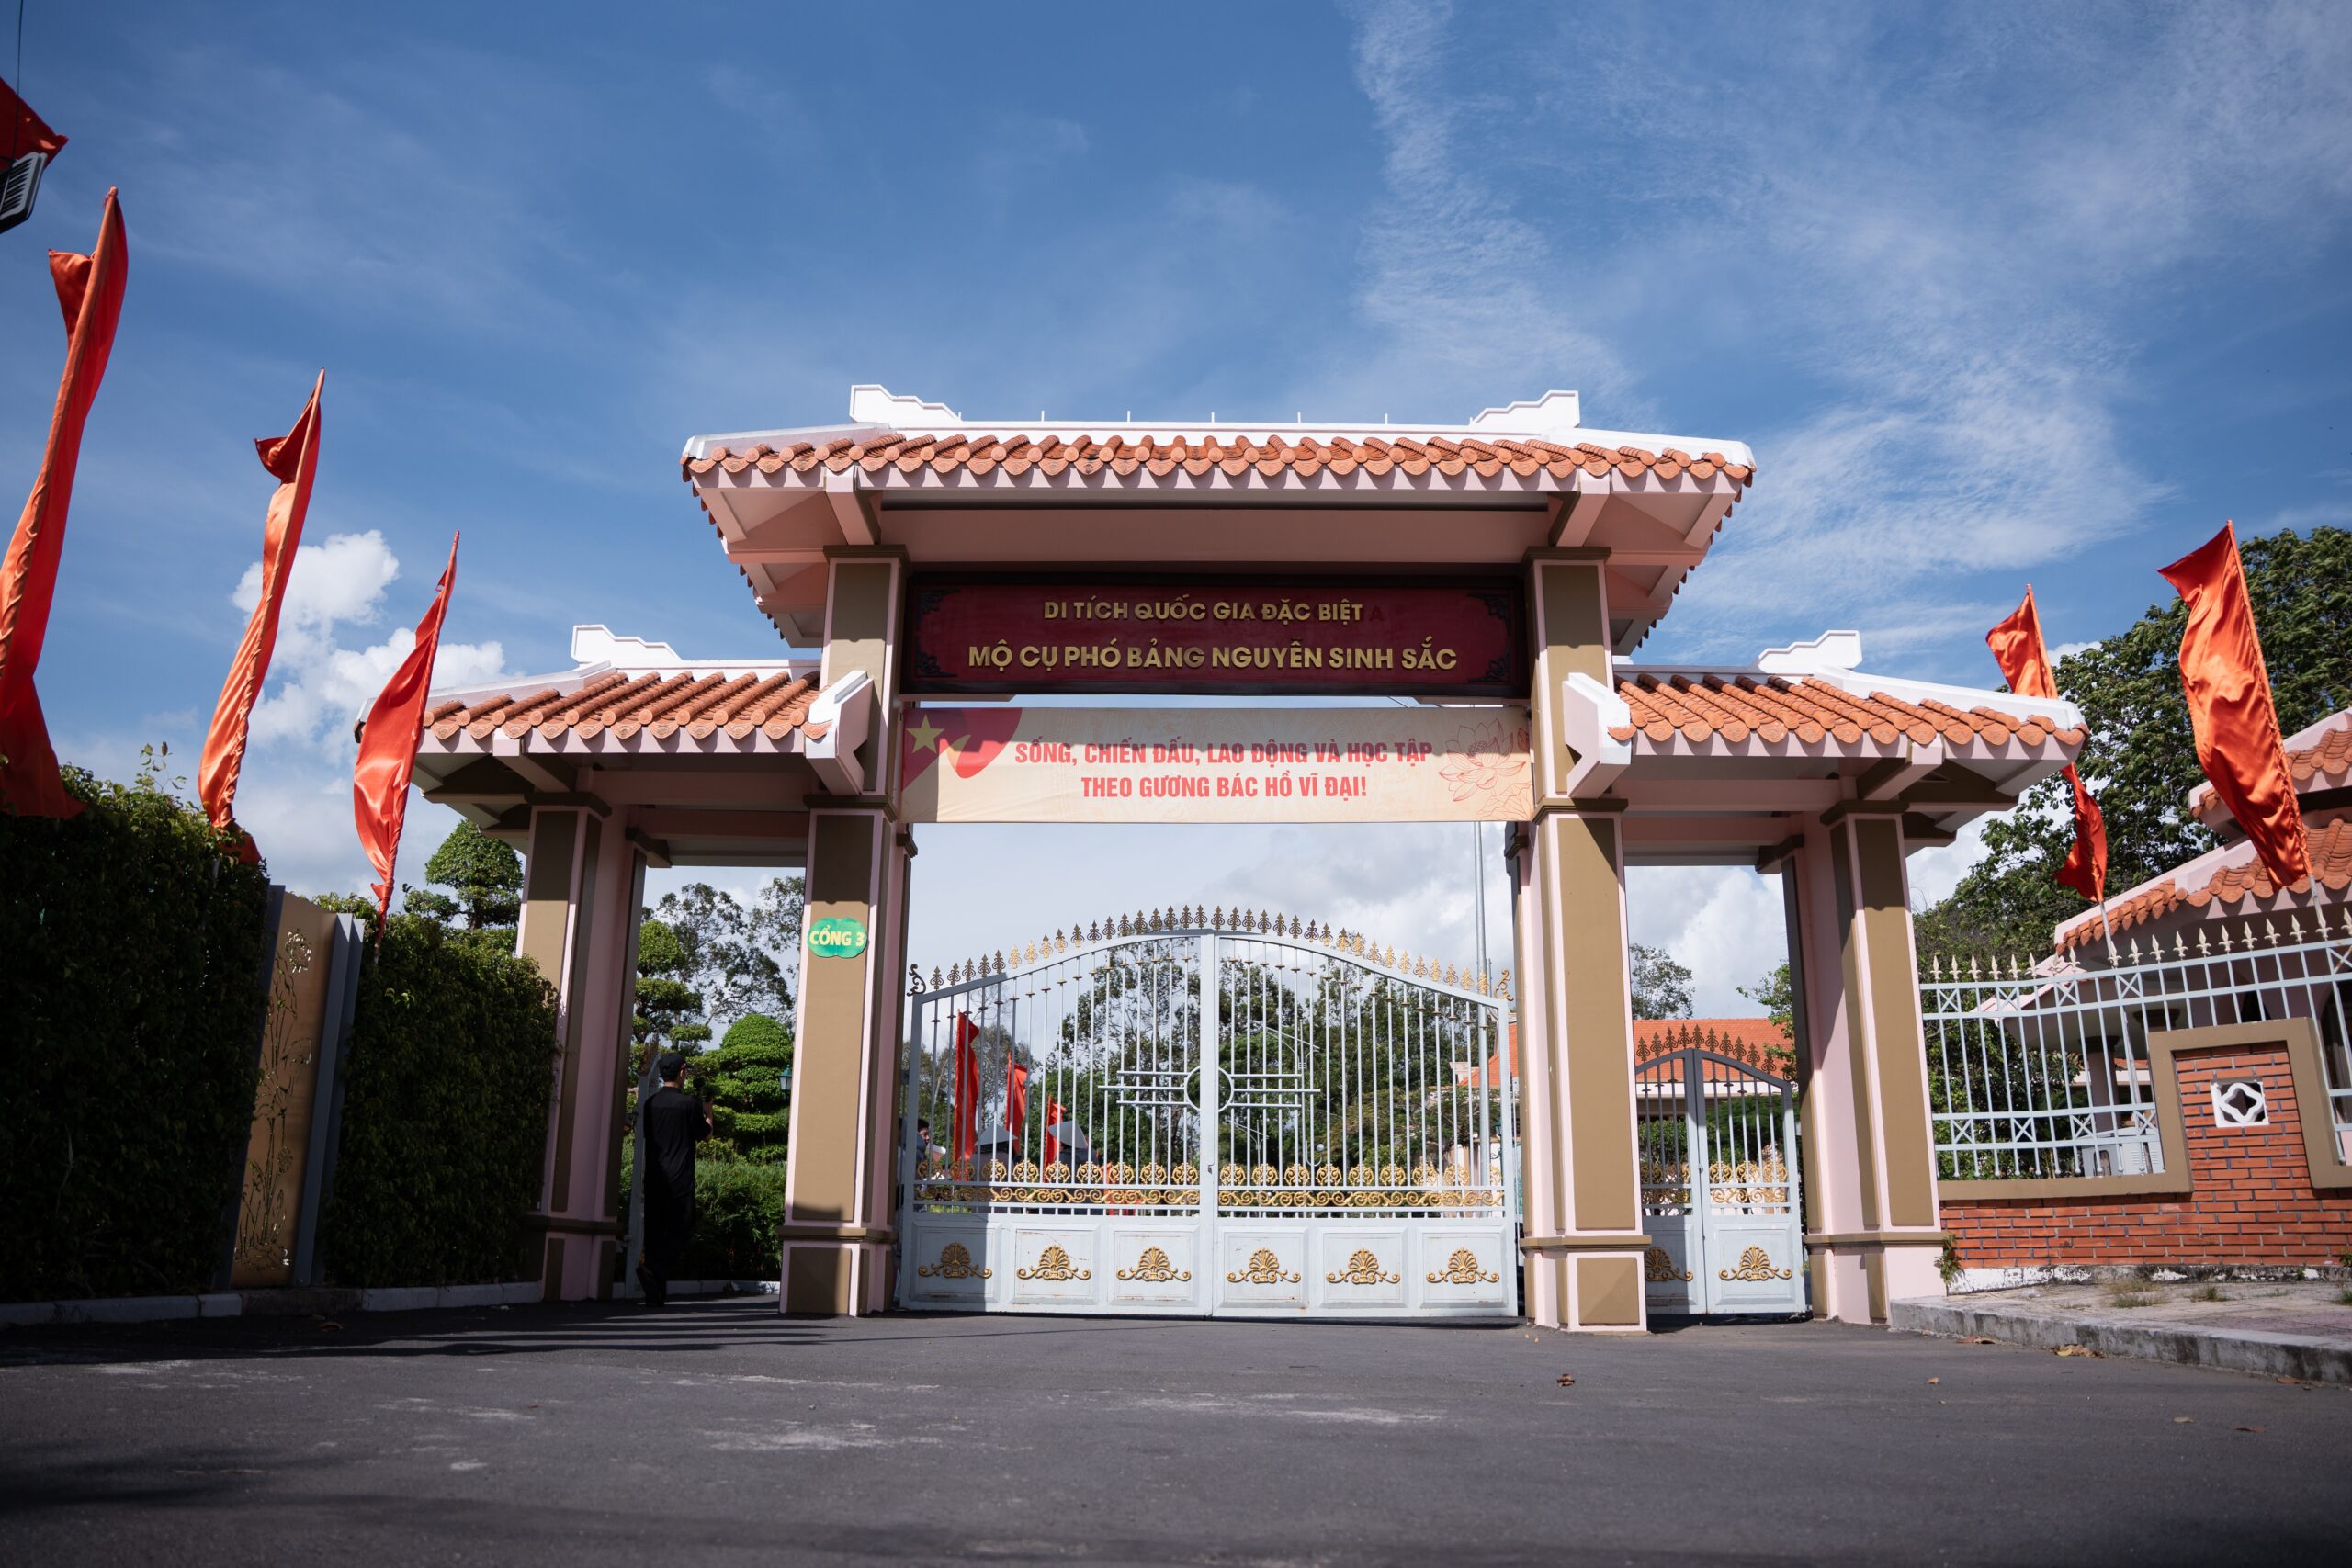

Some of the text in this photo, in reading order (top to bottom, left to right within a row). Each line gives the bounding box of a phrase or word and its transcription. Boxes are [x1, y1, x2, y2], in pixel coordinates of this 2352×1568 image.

[1044, 601, 1067, 619] DI
[1073, 594, 1128, 620] TÍCH
[1134, 593, 1206, 621] QUỐC
[1213, 601, 1256, 620] GIA
[1261, 598, 1311, 626] ĐẶC
[1318, 598, 1363, 626] BIỆT
[968, 638, 1012, 672] MỘ
[1019, 646, 1057, 672] CỤ
[1064, 637, 1122, 669] PHÓ
[1126, 637, 1205, 669] BẢNG
[1329, 647, 1394, 670] SINH
[1401, 635, 1457, 670] SẮC
[1014, 735, 1433, 768] SỐNG, CHIẾN ĐẤU, LAO ĐỘNG VÀ HỌC TẬP
[1080, 770, 1367, 802] THEO GƯƠNG BÁC HỒ VĨ ĐẠI!
[809, 924, 865, 947] CỔNG 3
